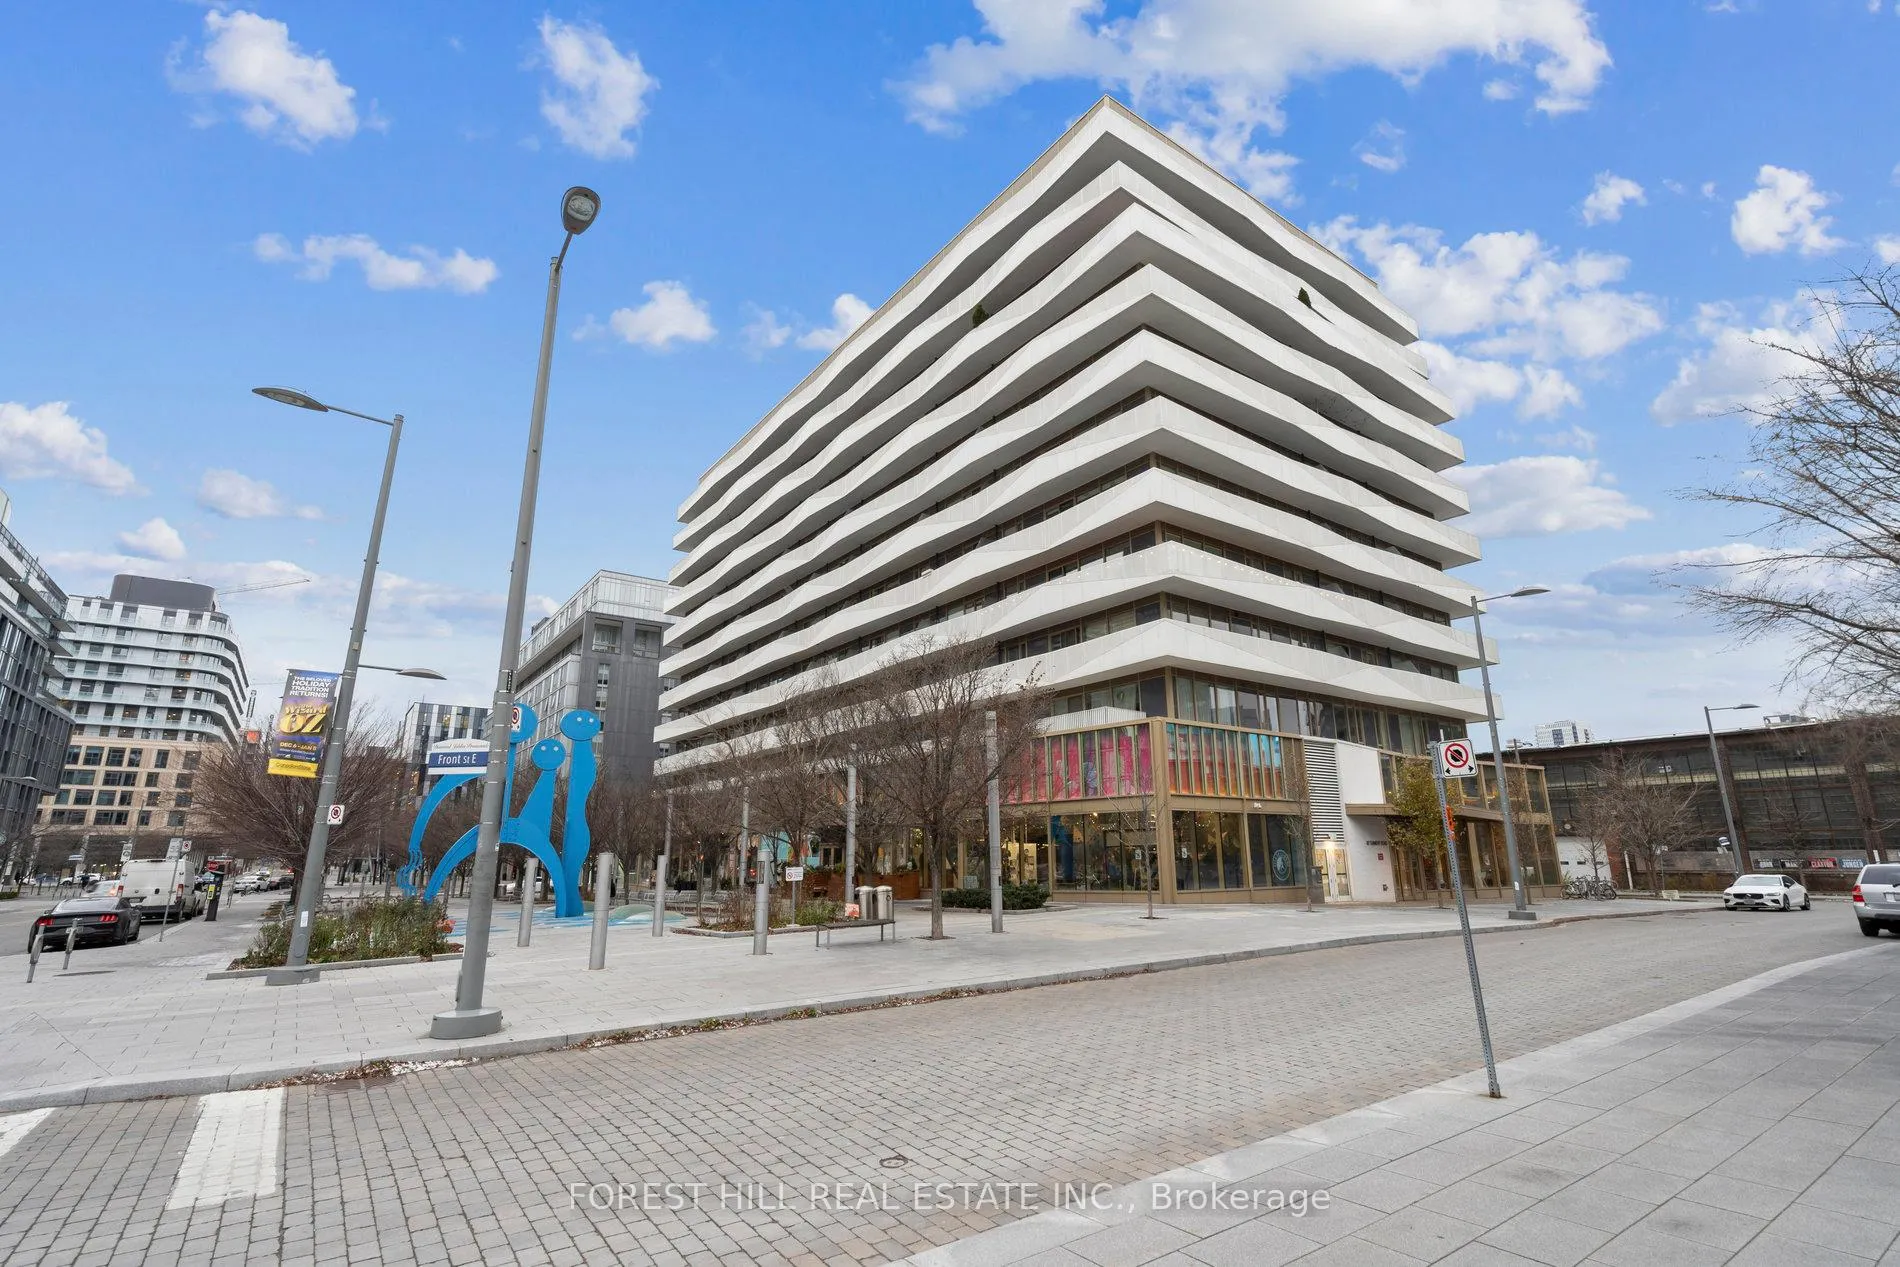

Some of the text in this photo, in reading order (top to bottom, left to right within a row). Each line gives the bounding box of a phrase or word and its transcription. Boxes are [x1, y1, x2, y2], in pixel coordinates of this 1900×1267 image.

[291, 685, 329, 693] TRADITION
[289, 690, 329, 698] RETURNS!
[438, 754, 461, 764] Front
[472, 753, 477, 763] E
